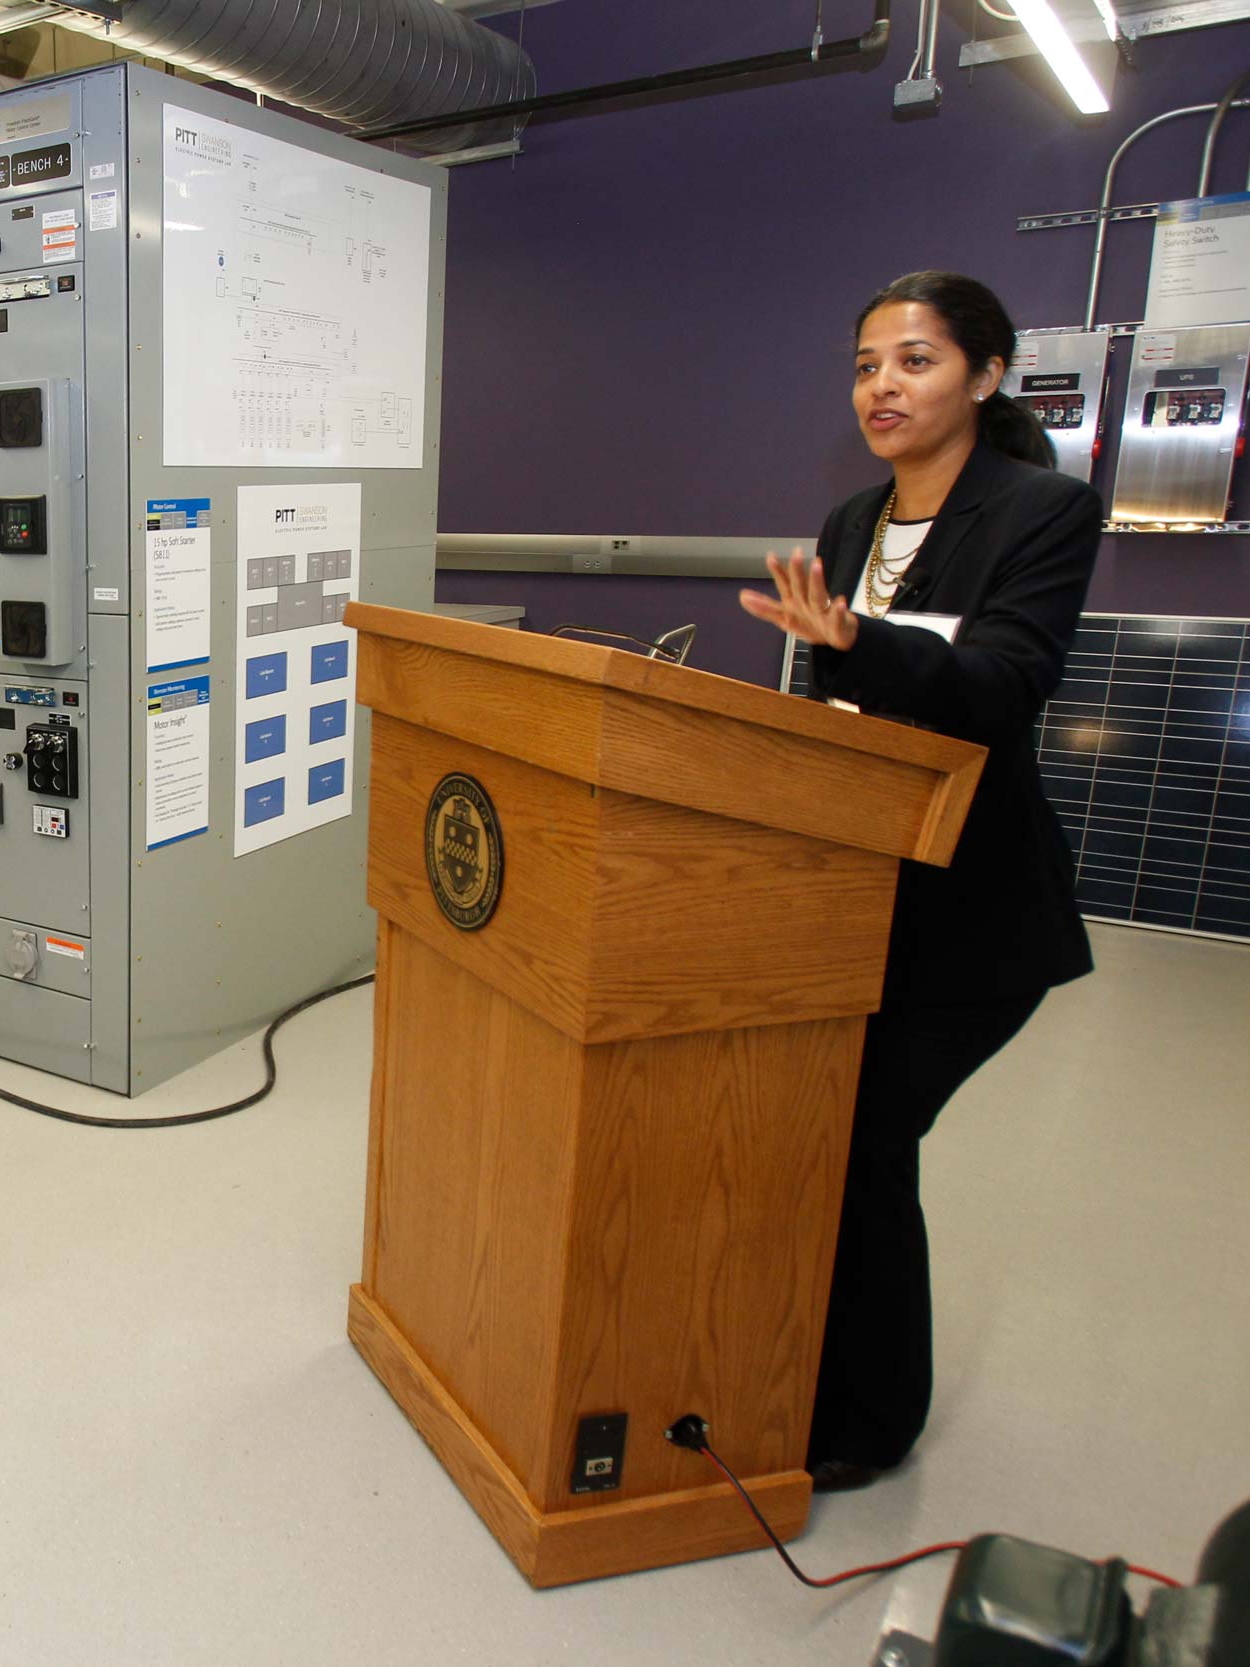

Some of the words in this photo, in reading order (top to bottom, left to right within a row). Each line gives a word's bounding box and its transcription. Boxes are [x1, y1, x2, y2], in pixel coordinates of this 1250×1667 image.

[175, 127, 197, 146] PITT
[202, 133, 231, 150] SWANSON
[17, 157, 51, 175] BENCH
[56, 154, 64, 166] 4
[1164, 226, 1216, 238] Heavy-Duty
[1163, 239, 1189, 249] Safety
[1191, 235, 1220, 245] Switch
[1031, 378, 1069, 387] GENERATOR
[275, 508, 296, 523] PITT
[299, 505, 327, 515] SWANSON
[299, 515, 327, 523] ENGINEERING
[154, 537, 161, 547] 15
[161, 537, 168, 547] hp
[169, 536, 179, 546] Soft
[180, 535, 196, 545] Starter
[154, 720, 168, 729] Motor
